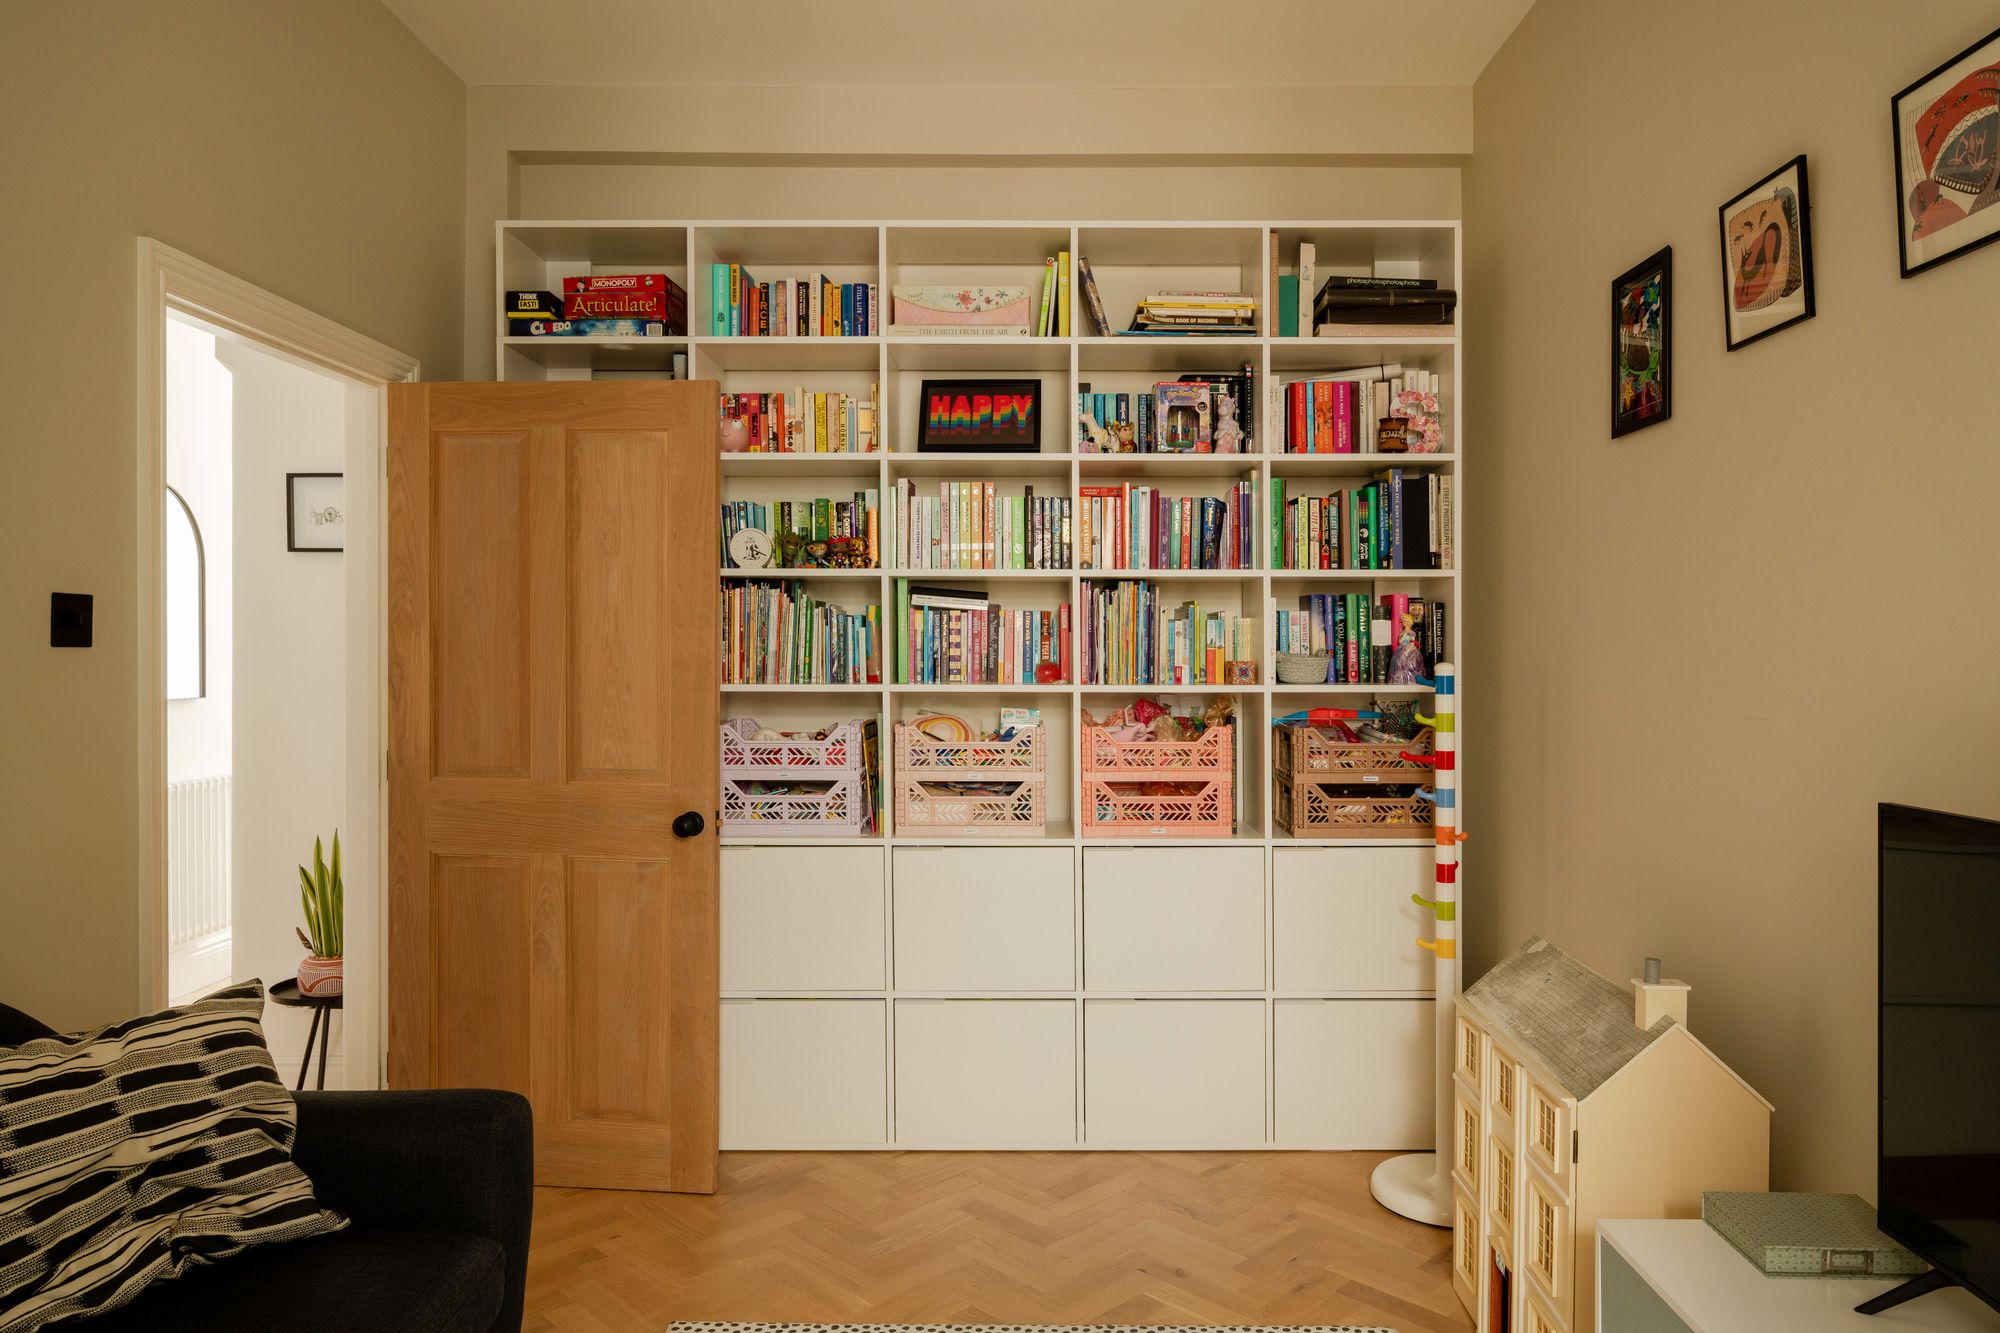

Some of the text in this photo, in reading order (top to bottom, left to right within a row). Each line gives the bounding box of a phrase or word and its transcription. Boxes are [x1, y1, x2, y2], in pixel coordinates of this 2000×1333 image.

[593, 279, 635, 288] MONOPOLY
[572, 297, 657, 316] Articulate!
[760, 284, 769, 329] CIRCE
[530, 321, 571, 335] CLUEDO
[930, 395, 1033, 435] HAPPY
[1042, 641, 1050, 660] TYGER
